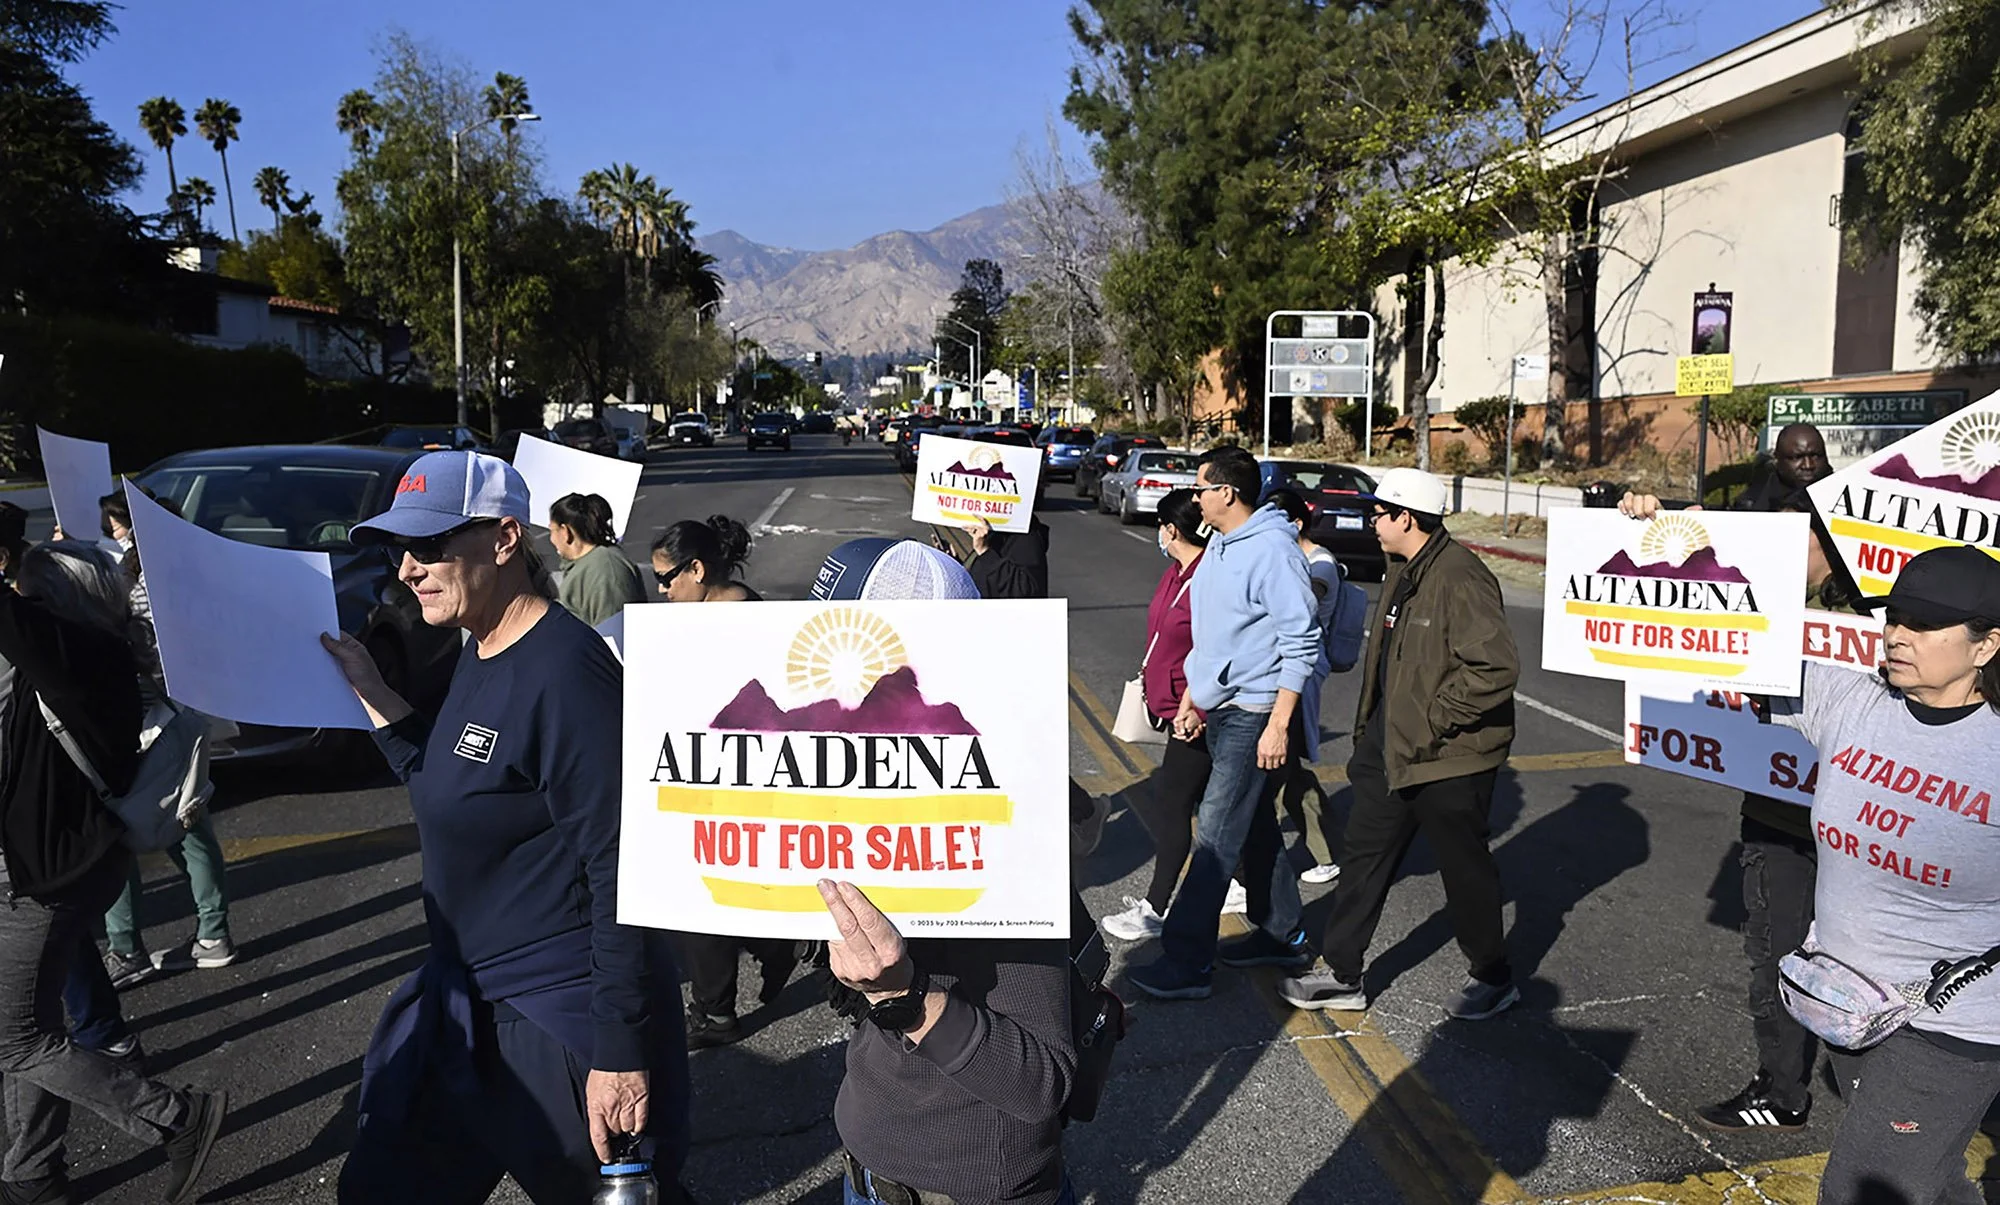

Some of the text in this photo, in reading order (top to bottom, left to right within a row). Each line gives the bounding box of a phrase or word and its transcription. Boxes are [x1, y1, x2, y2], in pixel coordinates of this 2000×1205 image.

[1711, 358, 1729, 368] SELL
[1799, 413, 1897, 423] PARISH SCHOOL
[1812, 397, 1925, 414] ELIZABETH
[926, 471, 1019, 495] ALTADENA
[938, 495, 1014, 515] NOT FOR SALE!
[1828, 484, 2000, 549] ALTAD
[1562, 574, 1762, 613] ALTADENA
[1585, 619, 1749, 655] NOT FOR SALE!
[650, 732, 1001, 789] ALTADENA
[1628, 723, 1726, 773] FOR
[1830, 744, 1993, 825] ALTADENA
[1856, 800, 1915, 839] NOT
[694, 820, 985, 872] NOT FOR SALE!
[1817, 821, 1953, 888] FOR SALE!
[1029, 920, 1055, 928] Printing
